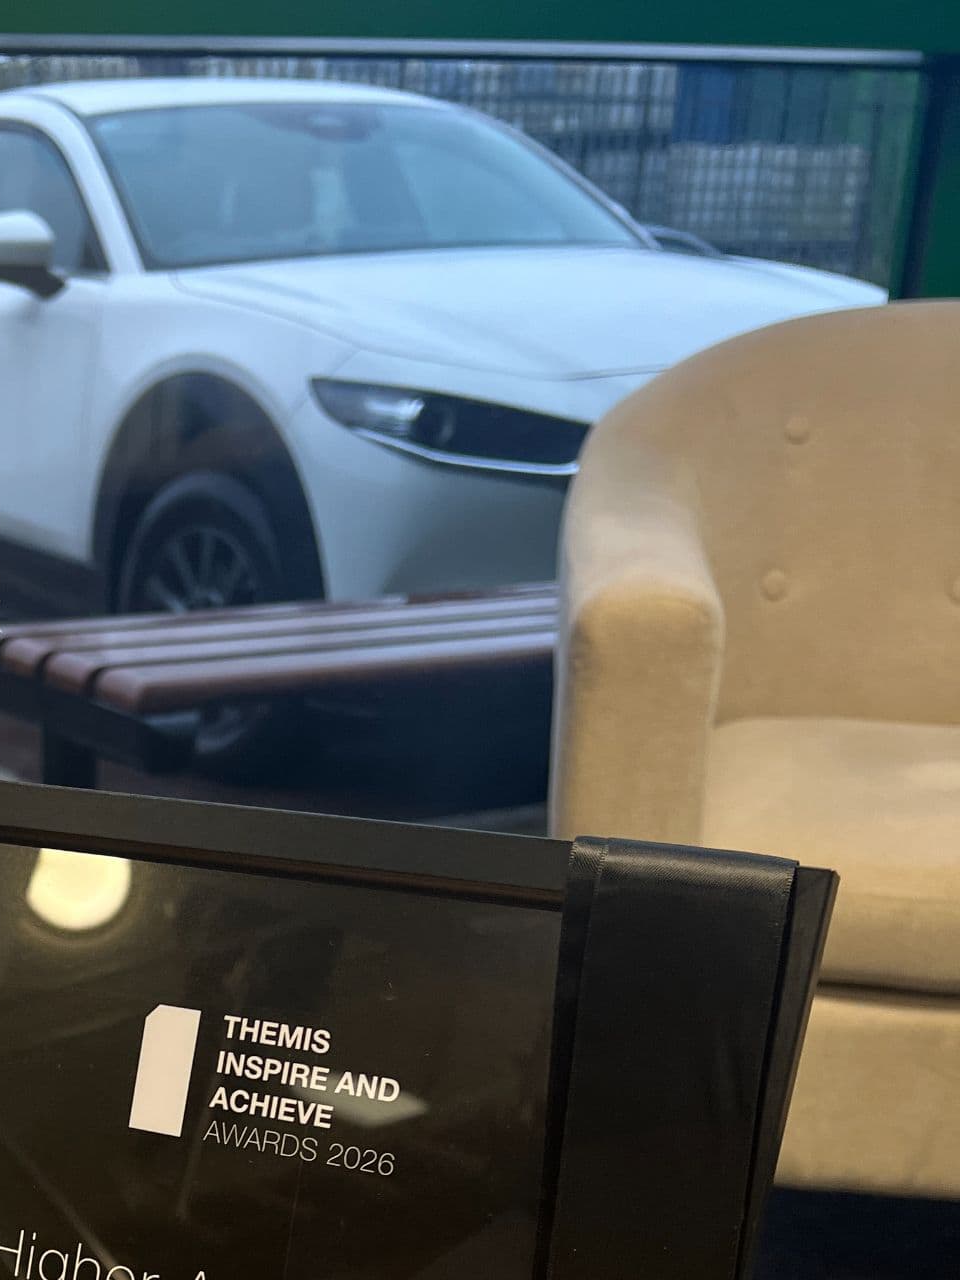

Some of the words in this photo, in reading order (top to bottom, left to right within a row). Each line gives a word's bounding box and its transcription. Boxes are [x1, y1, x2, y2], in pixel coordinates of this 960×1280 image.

[224, 1015, 331, 1054] THEMIS
[216, 1051, 330, 1091] INSPIRE
[334, 1072, 400, 1102] AND
[209, 1086, 334, 1129] ACHIEVE
[203, 1121, 318, 1162] AWARDS
[326, 1143, 395, 1176] 2026
